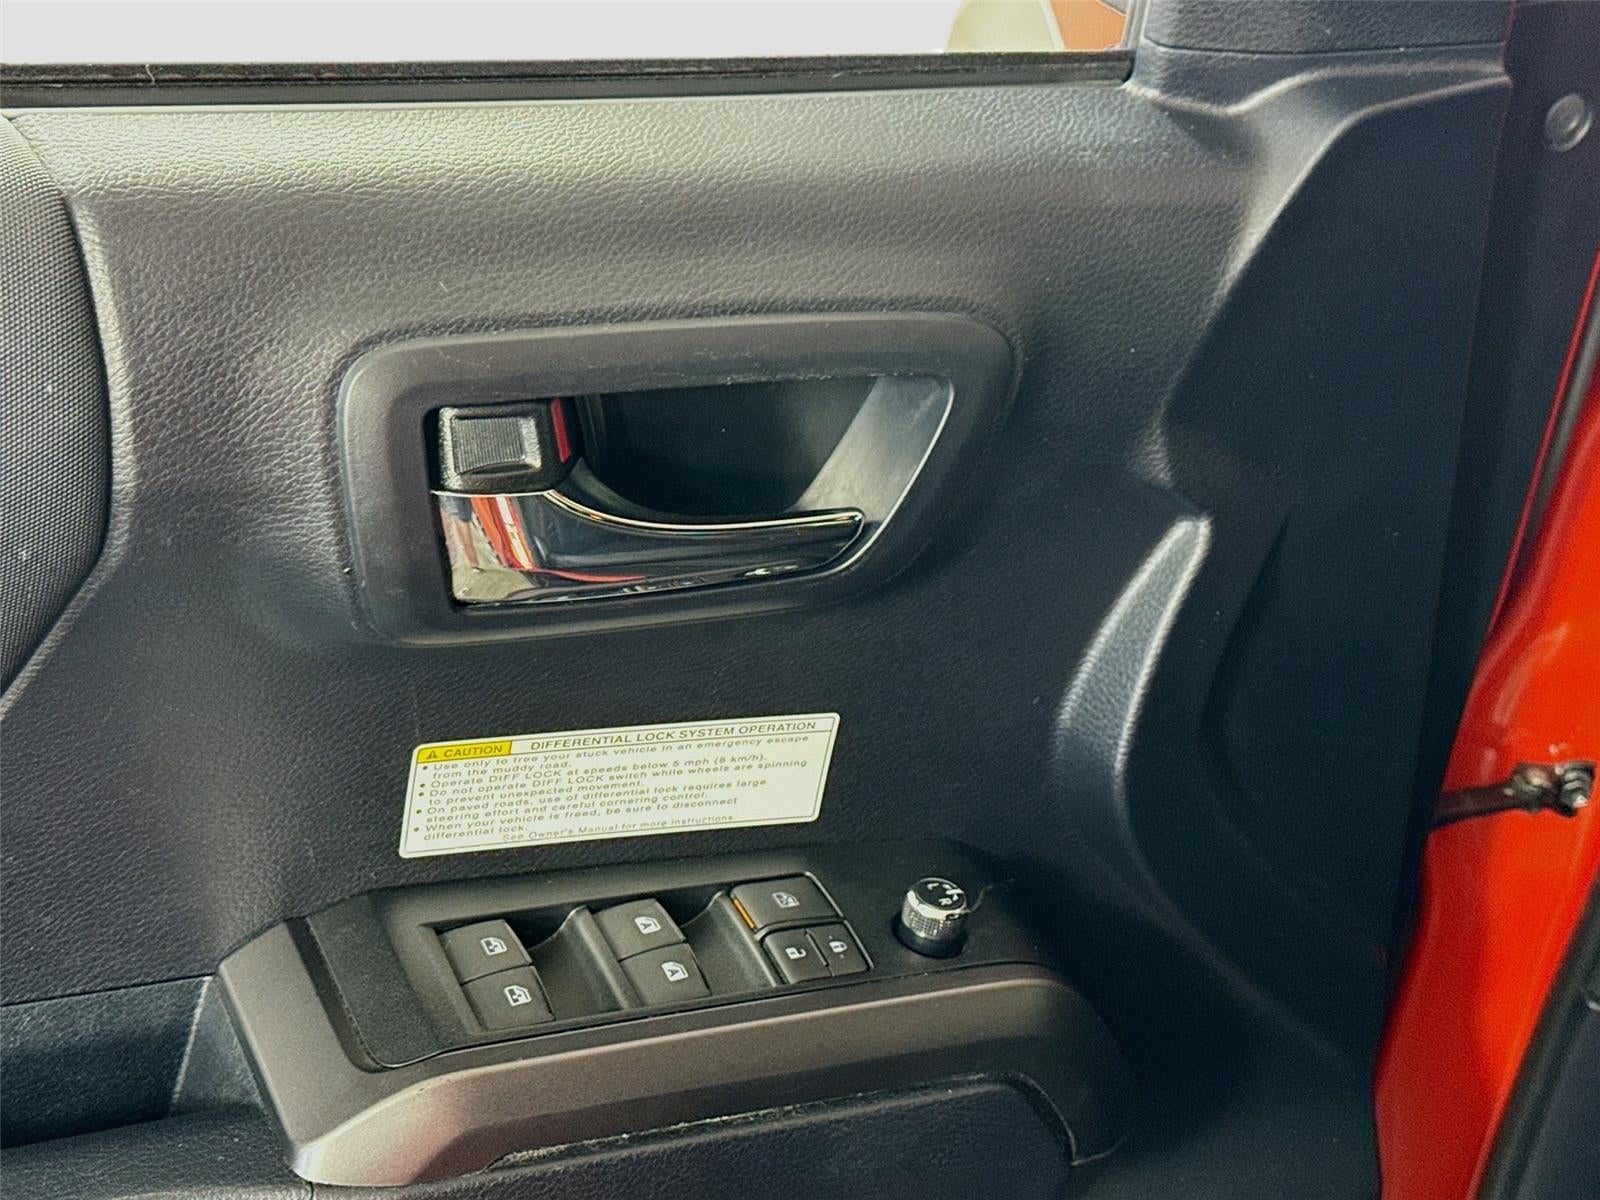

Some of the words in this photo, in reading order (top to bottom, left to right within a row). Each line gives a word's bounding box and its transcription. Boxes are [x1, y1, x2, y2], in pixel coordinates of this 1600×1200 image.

[530, 734, 631, 750] DIFFERENTIAL
[636, 730, 675, 742] LOCK
[678, 726, 734, 739] SYSTEM
[738, 720, 816, 735] OPERATION
[433, 762, 458, 771] Use
[463, 758, 491, 770] only
[496, 757, 508, 765] to
[513, 754, 538, 763] free
[543, 752, 570, 762] your
[575, 749, 608, 758] stuck
[613, 745, 656, 756] vehicle
[677, 743, 694, 751] an
[696, 737, 762, 750] emergency
[766, 735, 808, 745] escape
[443, 744, 502, 758] CAUTION
[429, 788, 447, 797] Do
[452, 786, 472, 795] not
[477, 782, 526, 794] operate
[532, 778, 562, 787] DIFF
[567, 775, 604, 784] LOCK
[608, 771, 647, 780] switch
[652, 768, 683, 777] while
[687, 764, 729, 775] wheels
[757, 759, 807, 771] spinning
[430, 777, 483, 789] Operate
[488, 773, 520, 783] DIFF
[524, 769, 561, 779] LOCK
[566, 768, 578, 776] at
[583, 764, 627, 775] speeds
[632, 761, 668, 771] below
[683, 758, 709, 768] mph
[433, 770, 462, 779] from
[470, 768, 487, 776] the
[492, 764, 535, 774] muddy
[426, 806, 445, 815] On
[450, 802, 489, 813] paved
[582, 788, 649, 800] differential
[654, 785, 677, 794] lock
[682, 781, 732, 793] requires
[736, 779, 766, 788] large
[426, 811, 479, 824] steering
[482, 808, 519, 817] effort
[523, 805, 547, 813] and
[551, 801, 595, 811] careful
[599, 796, 658, 808] cornering
[429, 798, 441, 806] to
[446, 794, 494, 805] prevent
[499, 786, 573, 800] unexpected
[425, 821, 461, 831] When
[466, 819, 495, 829] your
[499, 814, 544, 825] vehicle
[606, 807, 620, 815] be
[625, 805, 652, 813] sure
[656, 803, 668, 811] to
[672, 798, 737, 809] disconnect
[423, 828, 494, 841] differential
[498, 824, 528, 833] lock.
[502, 832, 524, 841] See
[578, 824, 618, 833] Manual
[640, 820, 667, 828] more
